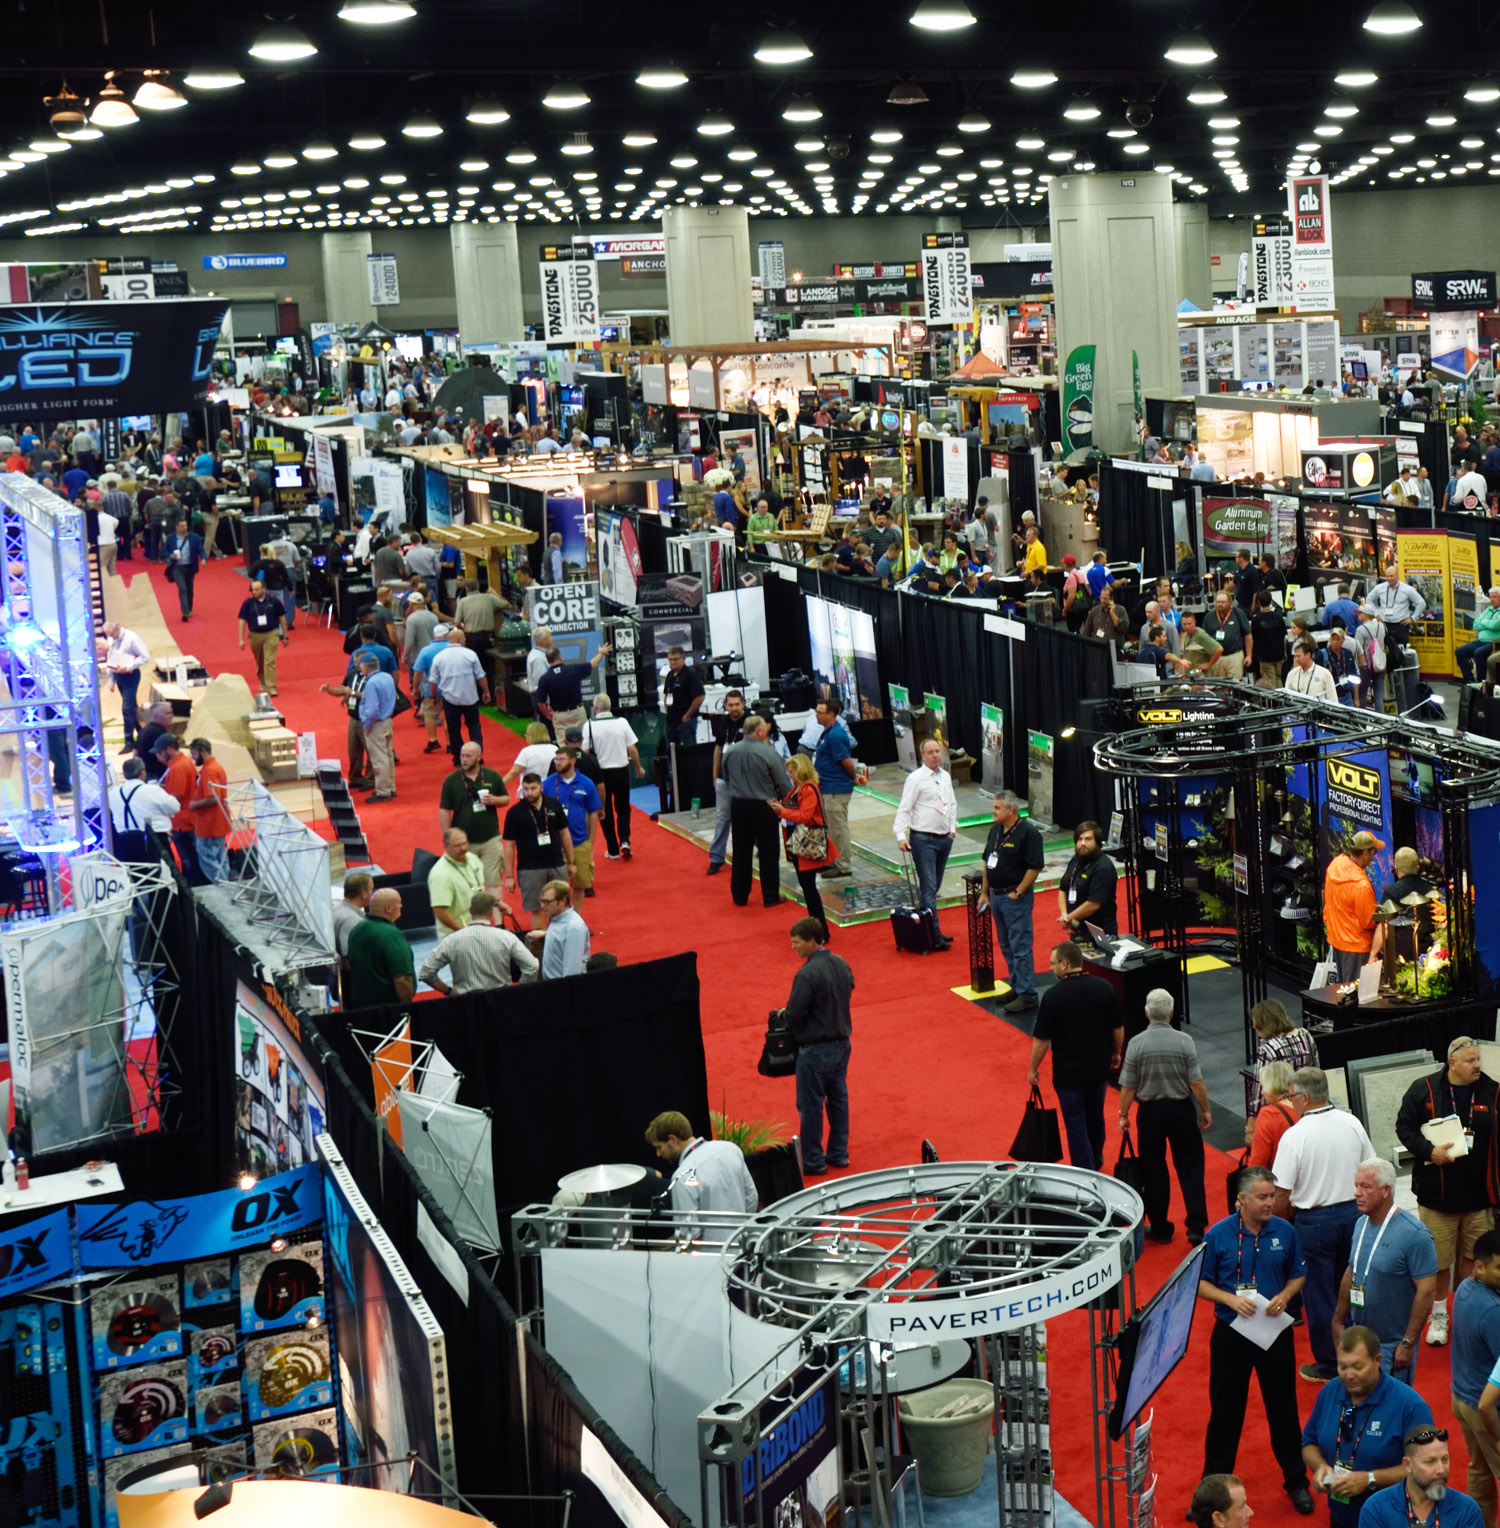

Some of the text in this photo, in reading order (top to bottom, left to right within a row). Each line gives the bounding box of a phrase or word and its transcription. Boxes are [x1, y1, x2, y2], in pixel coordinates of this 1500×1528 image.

[1122, 179, 1134, 188] N13
[1299, 218, 1322, 228] ALLAN
[1298, 230, 1322, 241] BLOCK
[228, 254, 286, 266] BLUEBIRD
[1256, 243, 1268, 302] PAVESTONE
[948, 252, 957, 308] 24000
[926, 256, 940, 320] PAVESTONE
[575, 264, 595, 325] 25000
[545, 268, 562, 338] PAVESTONE
[1216, 316, 1256, 324] MIRAGE
[756, 360, 795, 370] concorde
[1076, 363, 1092, 374] Big
[1065, 372, 1092, 384] Green
[1076, 380, 1092, 392] Egg
[43, 398, 114, 410] LIGHT FORM
[1284, 405, 1314, 414] LANDMARK
[1224, 506, 1262, 518] Aluminum
[1215, 520, 1268, 534] Garden Eding
[540, 586, 586, 601] OPEN
[534, 598, 596, 625] CORE
[648, 607, 694, 615] COMMERCIAL
[1138, 712, 1180, 721] VOLT
[1329, 761, 1378, 794] VOLT
[1328, 789, 1382, 816] FACTORY-DIRECT
[1329, 802, 1382, 827] PROFESSIONAL LIGHTING
[10, 956, 28, 1068] permaloc
[231, 1178, 304, 1232] OX
[231, 1228, 265, 1242] UNLEASH
[266, 1222, 278, 1232] THE
[304, 1250, 320, 1258] OX
[160, 1282, 175, 1290] OX
[890, 1264, 1112, 1332] PAVERTECH.COM
[310, 1333, 325, 1342] OX
[168, 1368, 184, 1378] OX
[318, 1418, 334, 1426] OX
